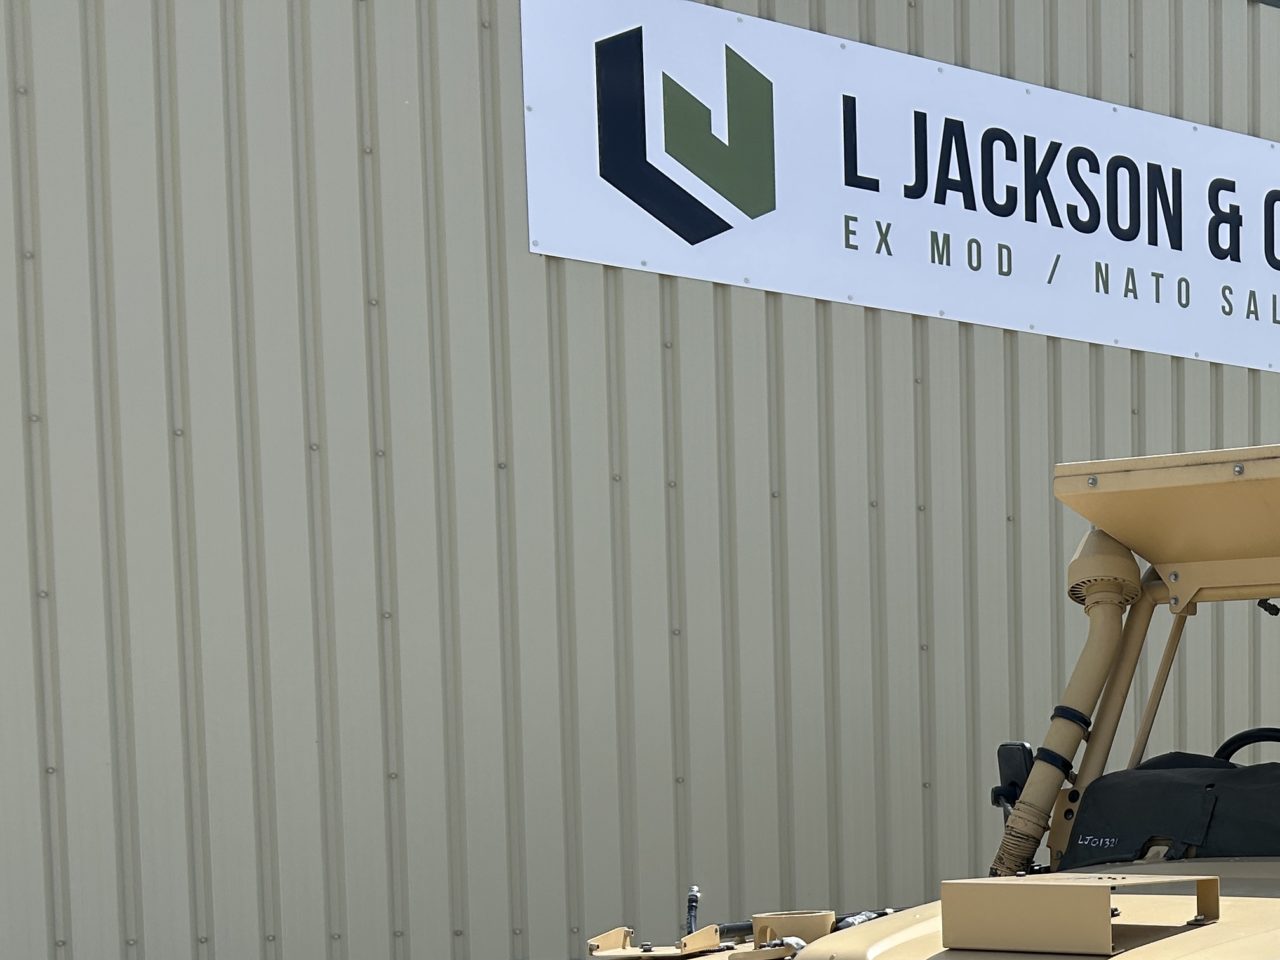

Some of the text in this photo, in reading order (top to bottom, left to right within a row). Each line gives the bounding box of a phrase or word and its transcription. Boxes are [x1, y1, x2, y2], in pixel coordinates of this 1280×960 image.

[842, 93, 880, 193] L
[903, 110, 1183, 252] JACKSON
[1207, 177, 1243, 263] &
[843, 214, 893, 257] EX
[930, 230, 1013, 277] MOD
[1046, 253, 1061, 285] /
[1094, 261, 1191, 309] NATO
